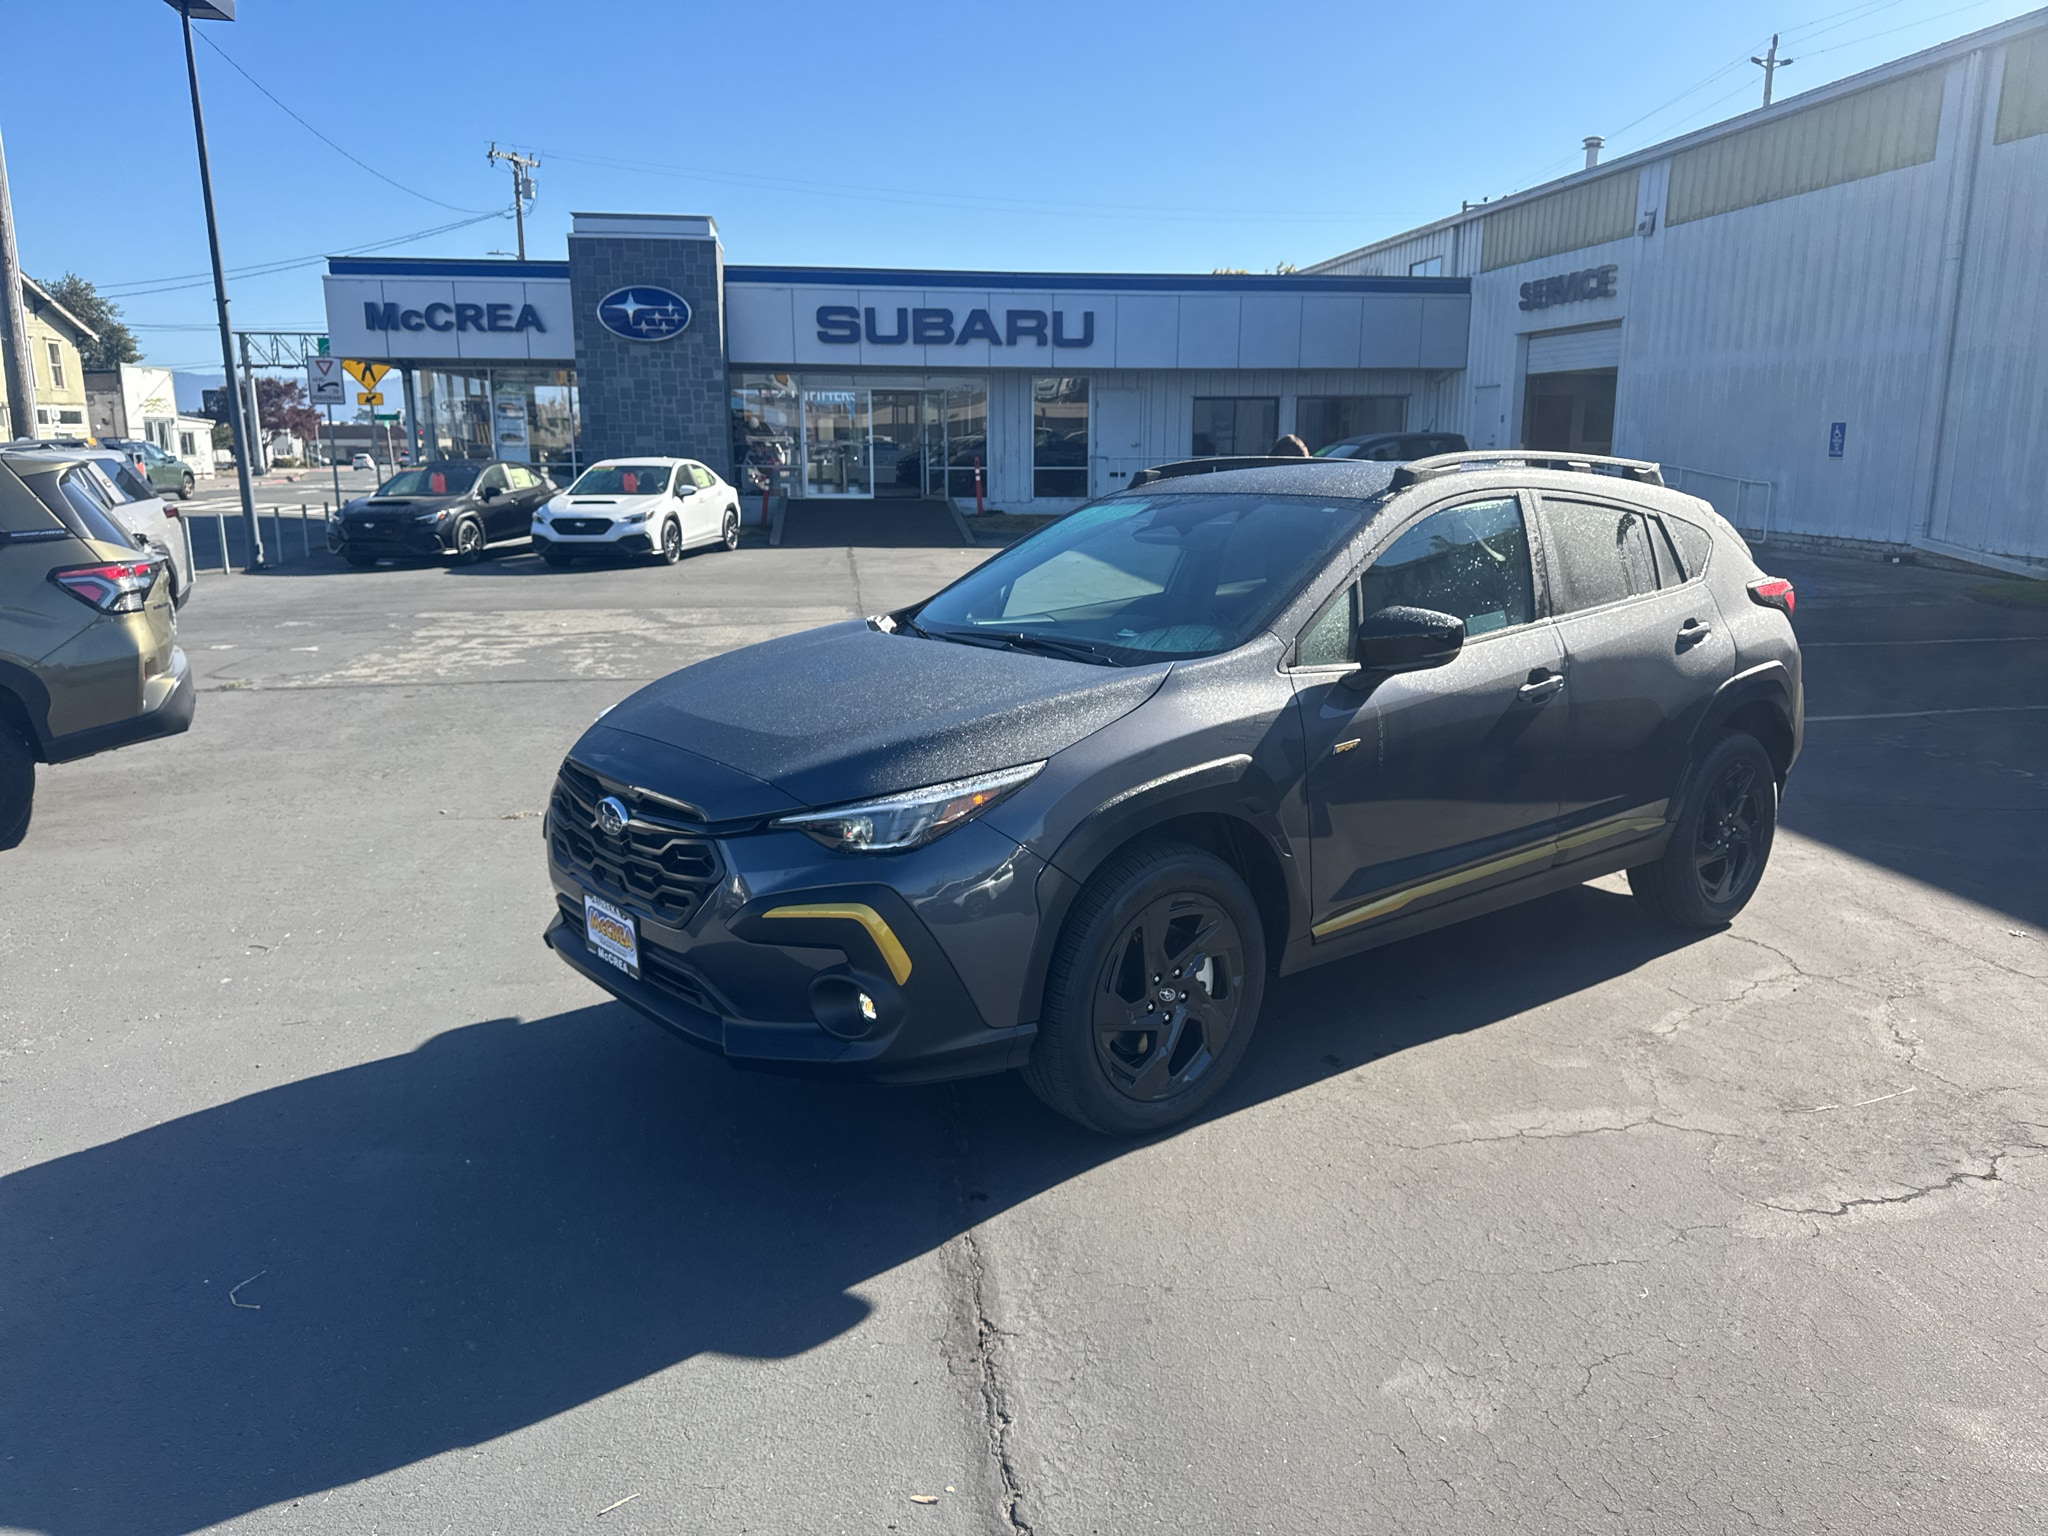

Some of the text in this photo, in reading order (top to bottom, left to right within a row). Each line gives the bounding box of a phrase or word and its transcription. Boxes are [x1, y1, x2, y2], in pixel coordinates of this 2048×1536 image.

[1518, 264, 1618, 311] SERVICE
[364, 302, 547, 333] McCREA
[816, 305, 1095, 348] SUBARU
[597, 946, 629, 975] McCREA
